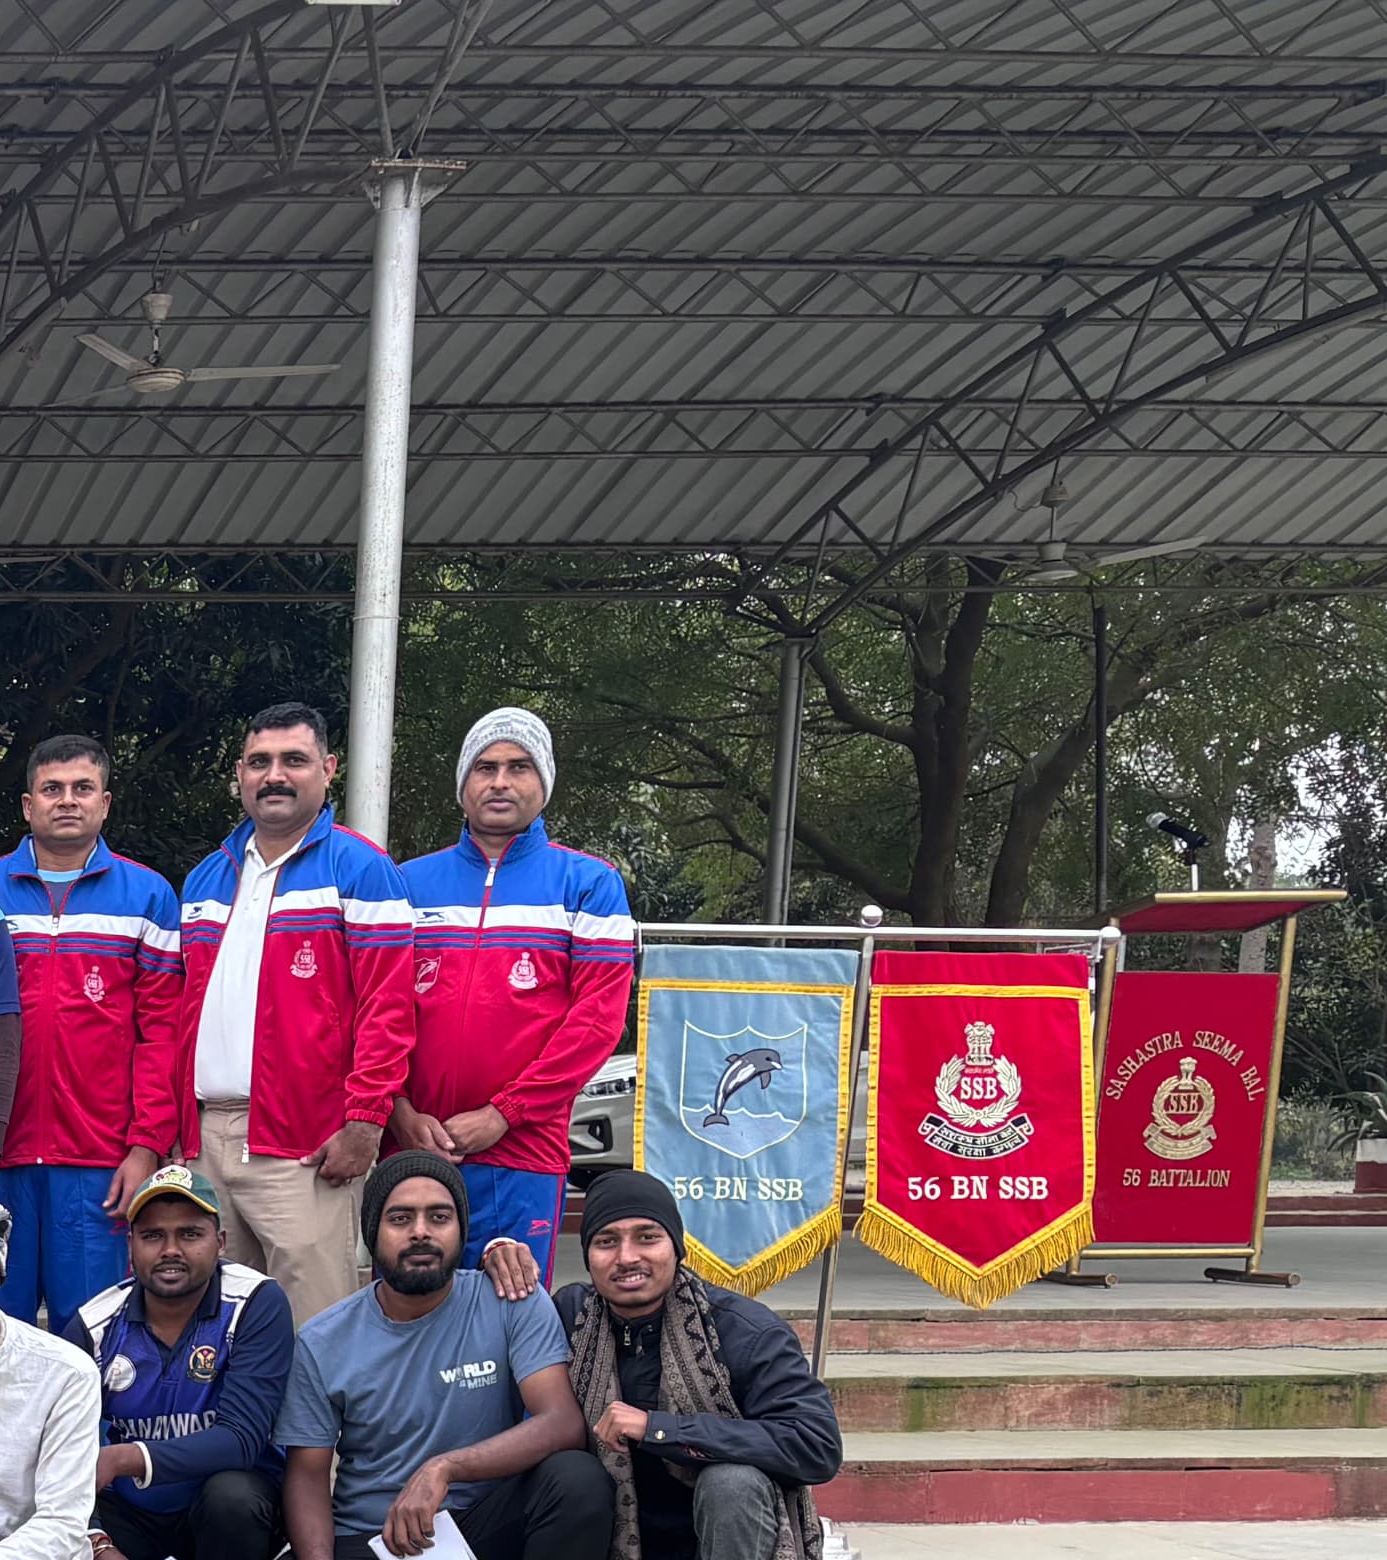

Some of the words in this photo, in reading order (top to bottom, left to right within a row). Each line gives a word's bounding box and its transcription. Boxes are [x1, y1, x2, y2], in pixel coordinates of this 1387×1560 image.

[1105, 1030, 1183, 1100] SASHASTRA
[1192, 1030, 1244, 1066] SEEMA
[1240, 1065, 1265, 1101] BAL
[960, 1077, 998, 1100] SSB
[674, 1176, 705, 1200] 56
[713, 1176, 748, 1201] BN
[757, 1177, 804, 1201] SSB
[907, 1176, 941, 1201] 56
[950, 1175, 989, 1200] BN
[998, 1175, 1049, 1200] SSB
[1122, 1168, 1141, 1186] 56
[1147, 1168, 1231, 1188] BATTALION
[467, 1374, 497, 1390] MINE
